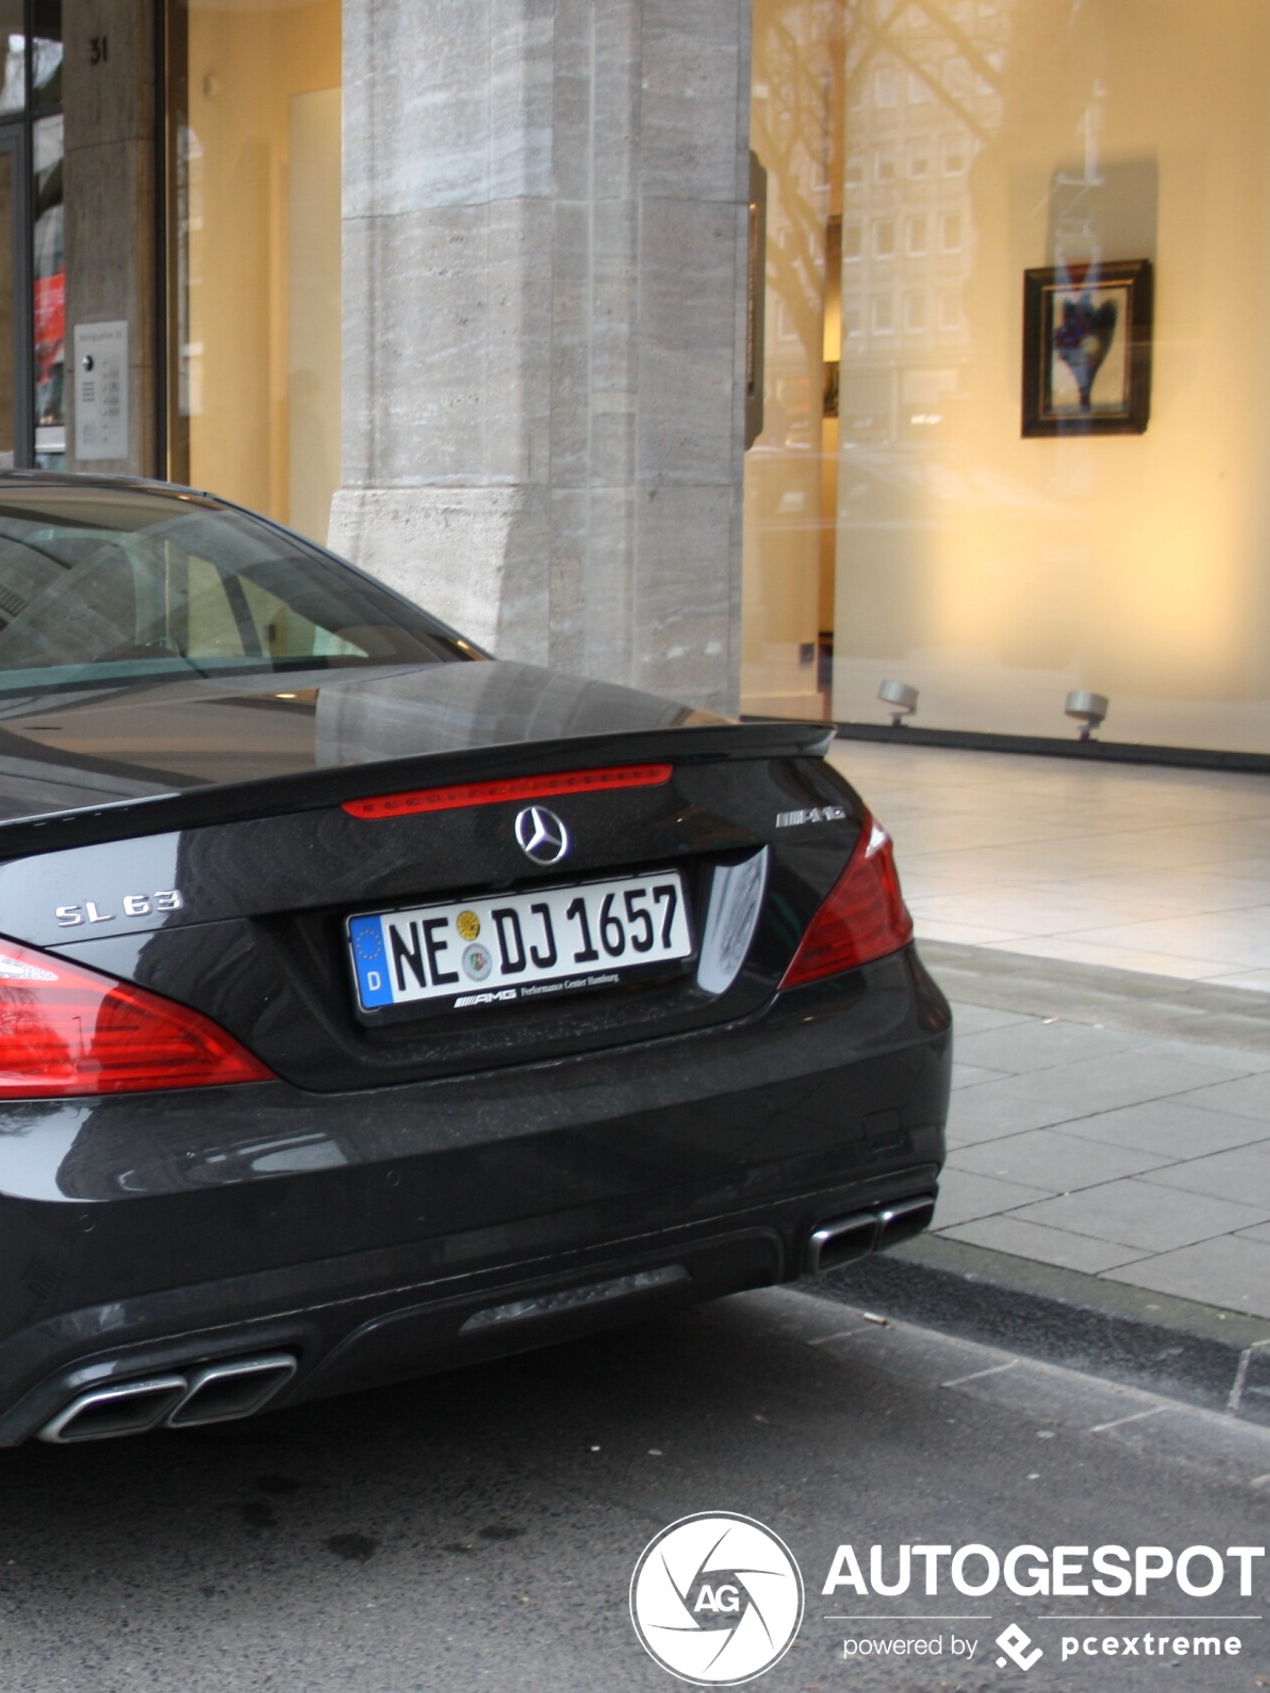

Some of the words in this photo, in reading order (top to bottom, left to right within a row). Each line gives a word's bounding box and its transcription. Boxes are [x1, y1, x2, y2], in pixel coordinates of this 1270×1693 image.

[89, 36, 108, 65] 31
[55, 902, 116, 928] SL
[123, 889, 184, 917] 63
[388, 917, 460, 991] NE
[491, 902, 558, 975] DJ
[566, 884, 678, 963] 1657
[367, 970, 381, 992] D
[521, 983, 564, 997] Performance
[564, 979, 587, 990] Center
[588, 973, 620, 986] Hamburg
